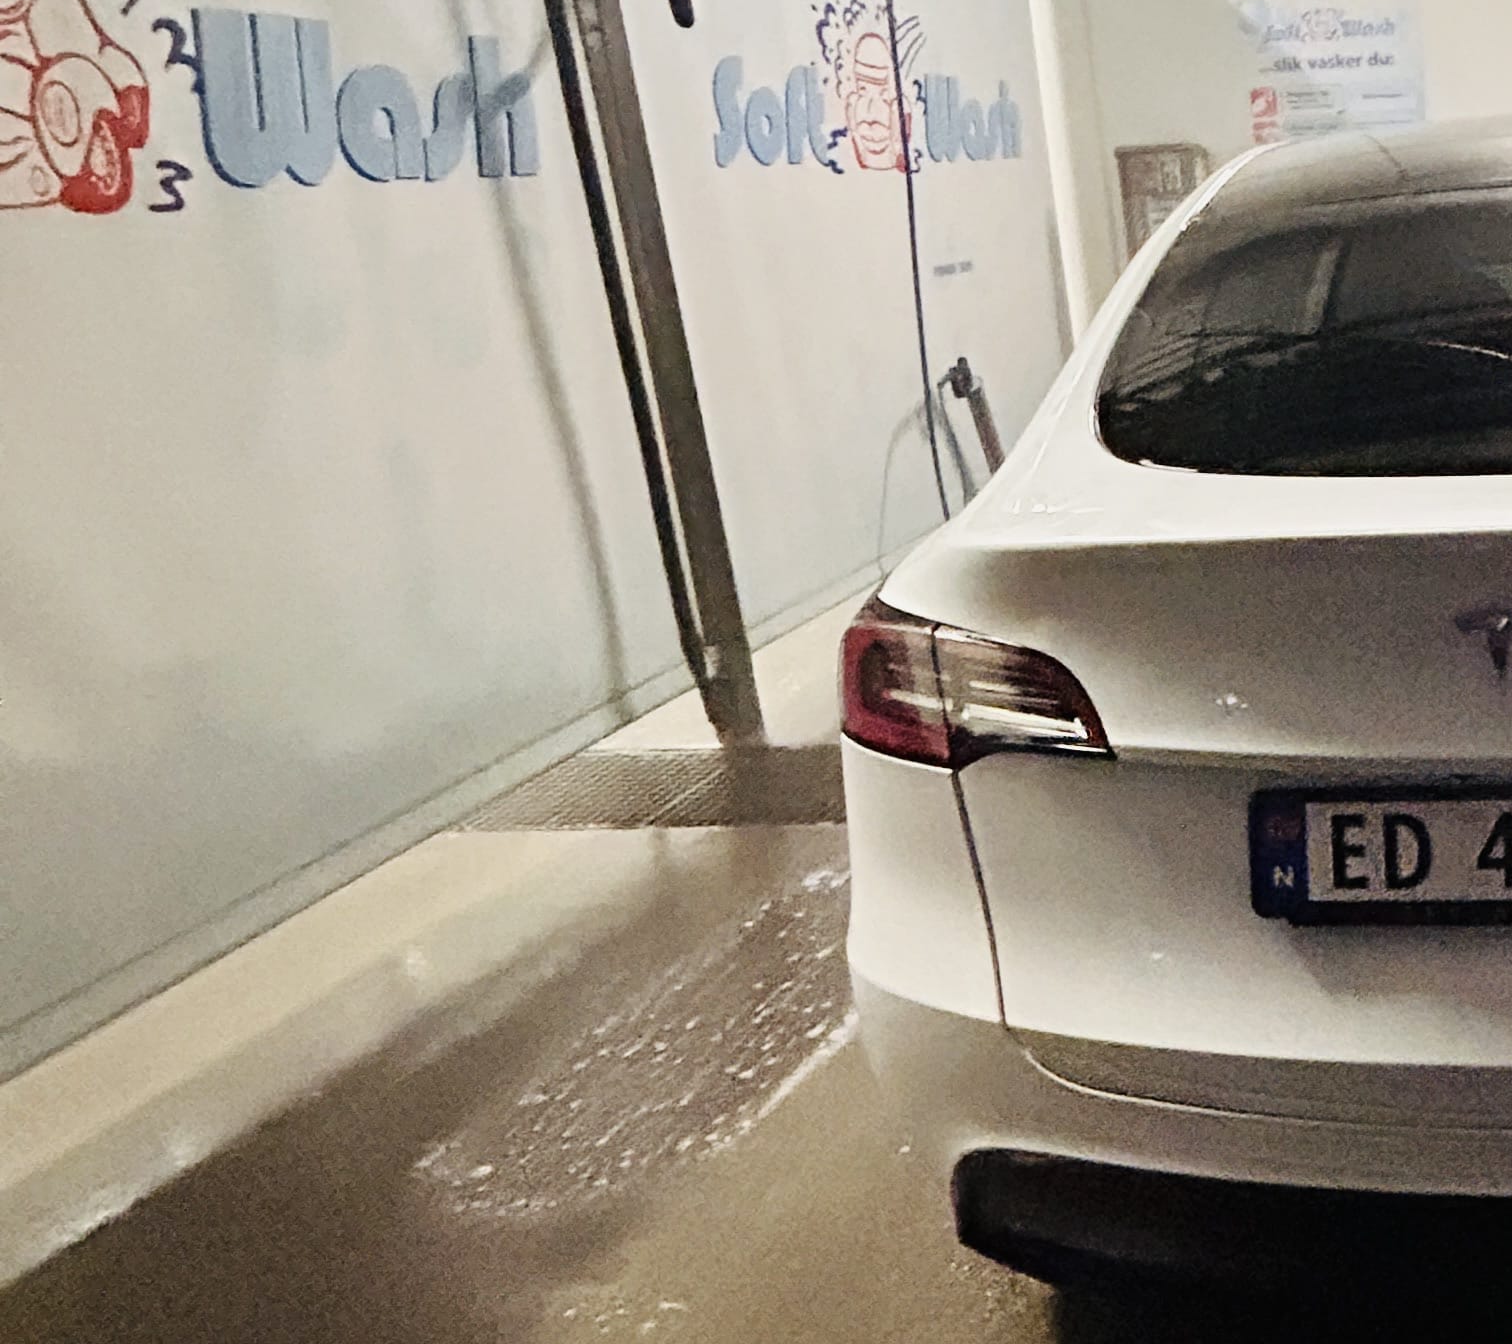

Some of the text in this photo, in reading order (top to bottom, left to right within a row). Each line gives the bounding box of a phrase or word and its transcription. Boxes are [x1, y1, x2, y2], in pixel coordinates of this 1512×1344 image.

[191, 7, 541, 188] Wash
[1307, 54, 1361, 69] vasker
[712, 55, 1022, 168] Soft Wash
[1273, 865, 1295, 888] N
[1329, 811, 1433, 891] ED
